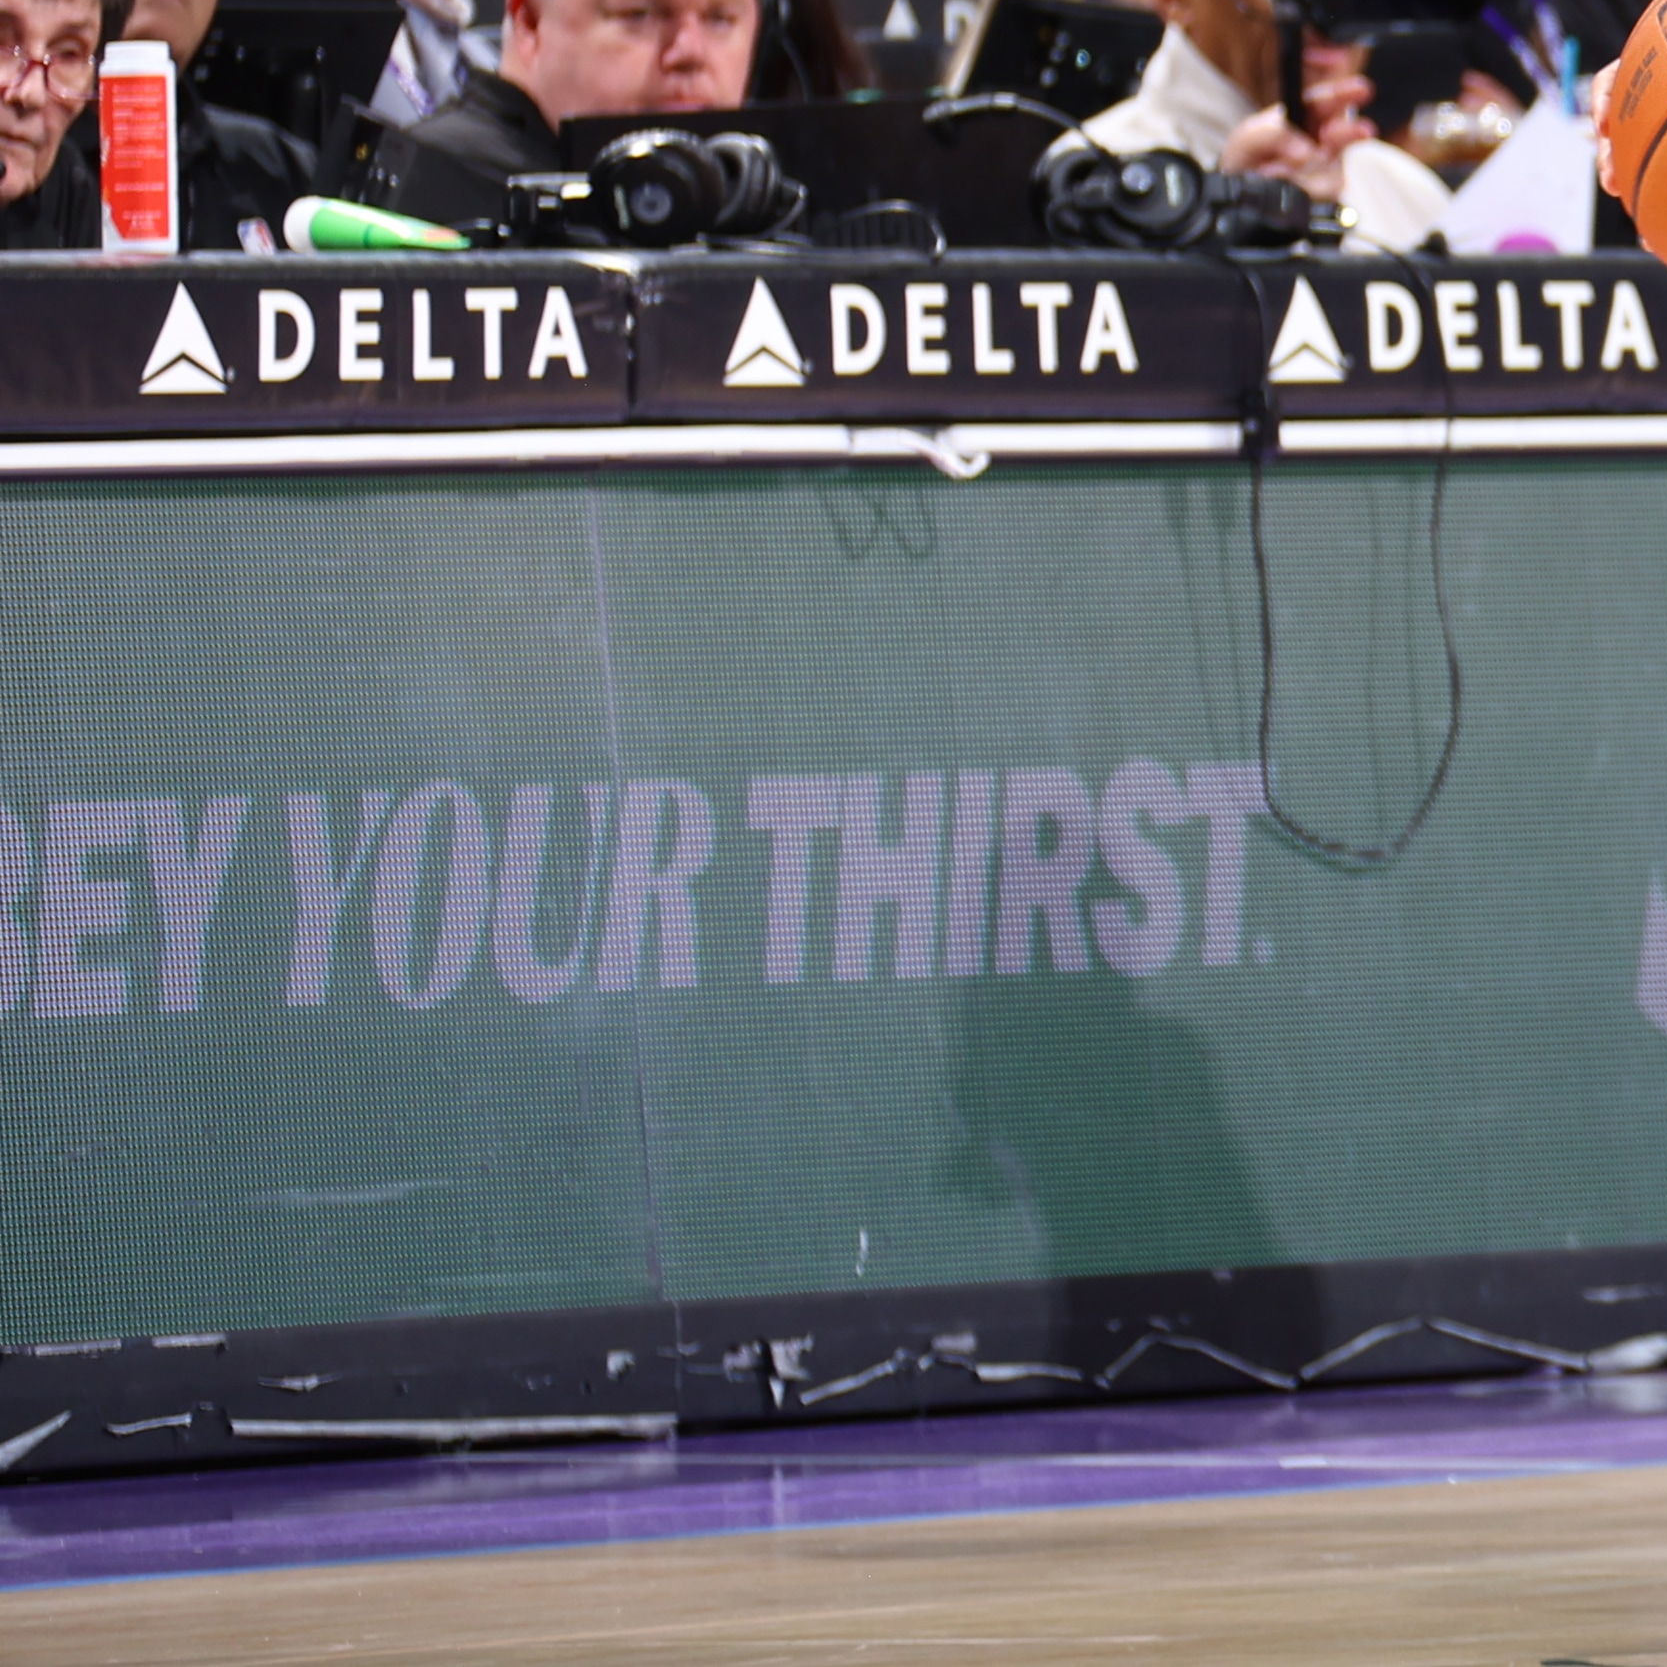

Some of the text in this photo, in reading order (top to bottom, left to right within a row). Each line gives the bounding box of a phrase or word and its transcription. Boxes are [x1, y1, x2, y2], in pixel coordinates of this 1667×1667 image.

[258, 286, 588, 383] DELTA
[830, 282, 1138, 375] DELTA
[1366, 281, 1658, 371] DELTA
[286, 779, 716, 1011] YOUR
[748, 758, 1276, 987] THIRST.
